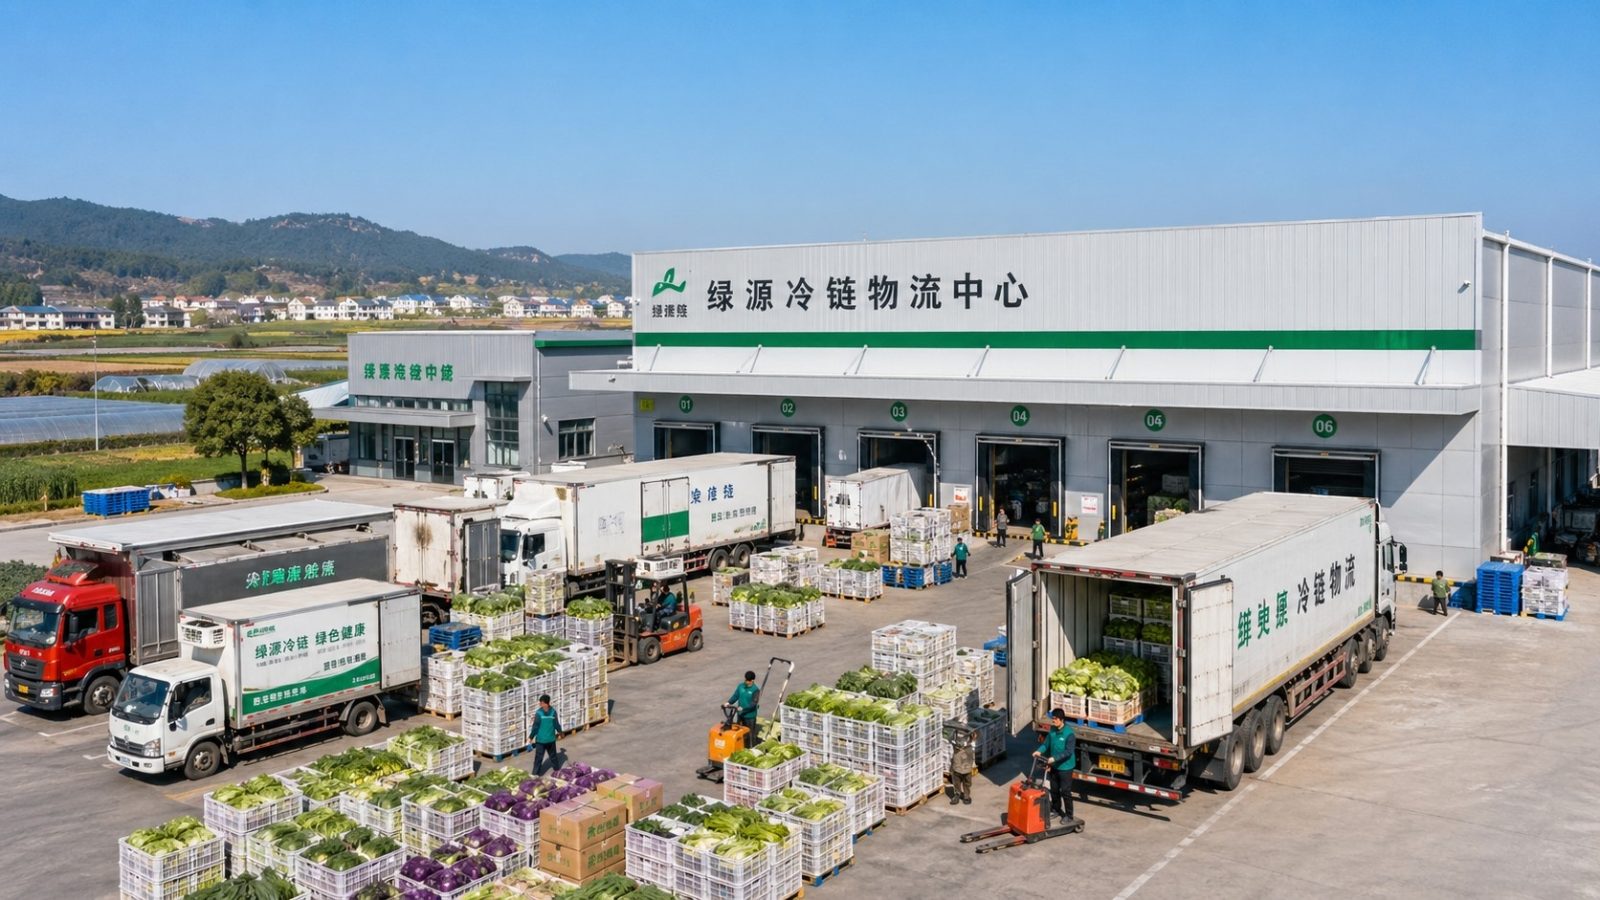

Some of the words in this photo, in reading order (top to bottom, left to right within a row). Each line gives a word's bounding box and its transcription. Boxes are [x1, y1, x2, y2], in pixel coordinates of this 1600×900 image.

[707, 272, 1029, 312] 绿源冷链物流中心
[782, 403, 793, 413] 02
[892, 407, 905, 417] 03
[1013, 410, 1027, 422] 04
[1316, 420, 1333, 432] 06
[1297, 553, 1355, 615] 冷链物流
[255, 635, 309, 659] 绿源冷链
[315, 622, 366, 646] 绿色健康
